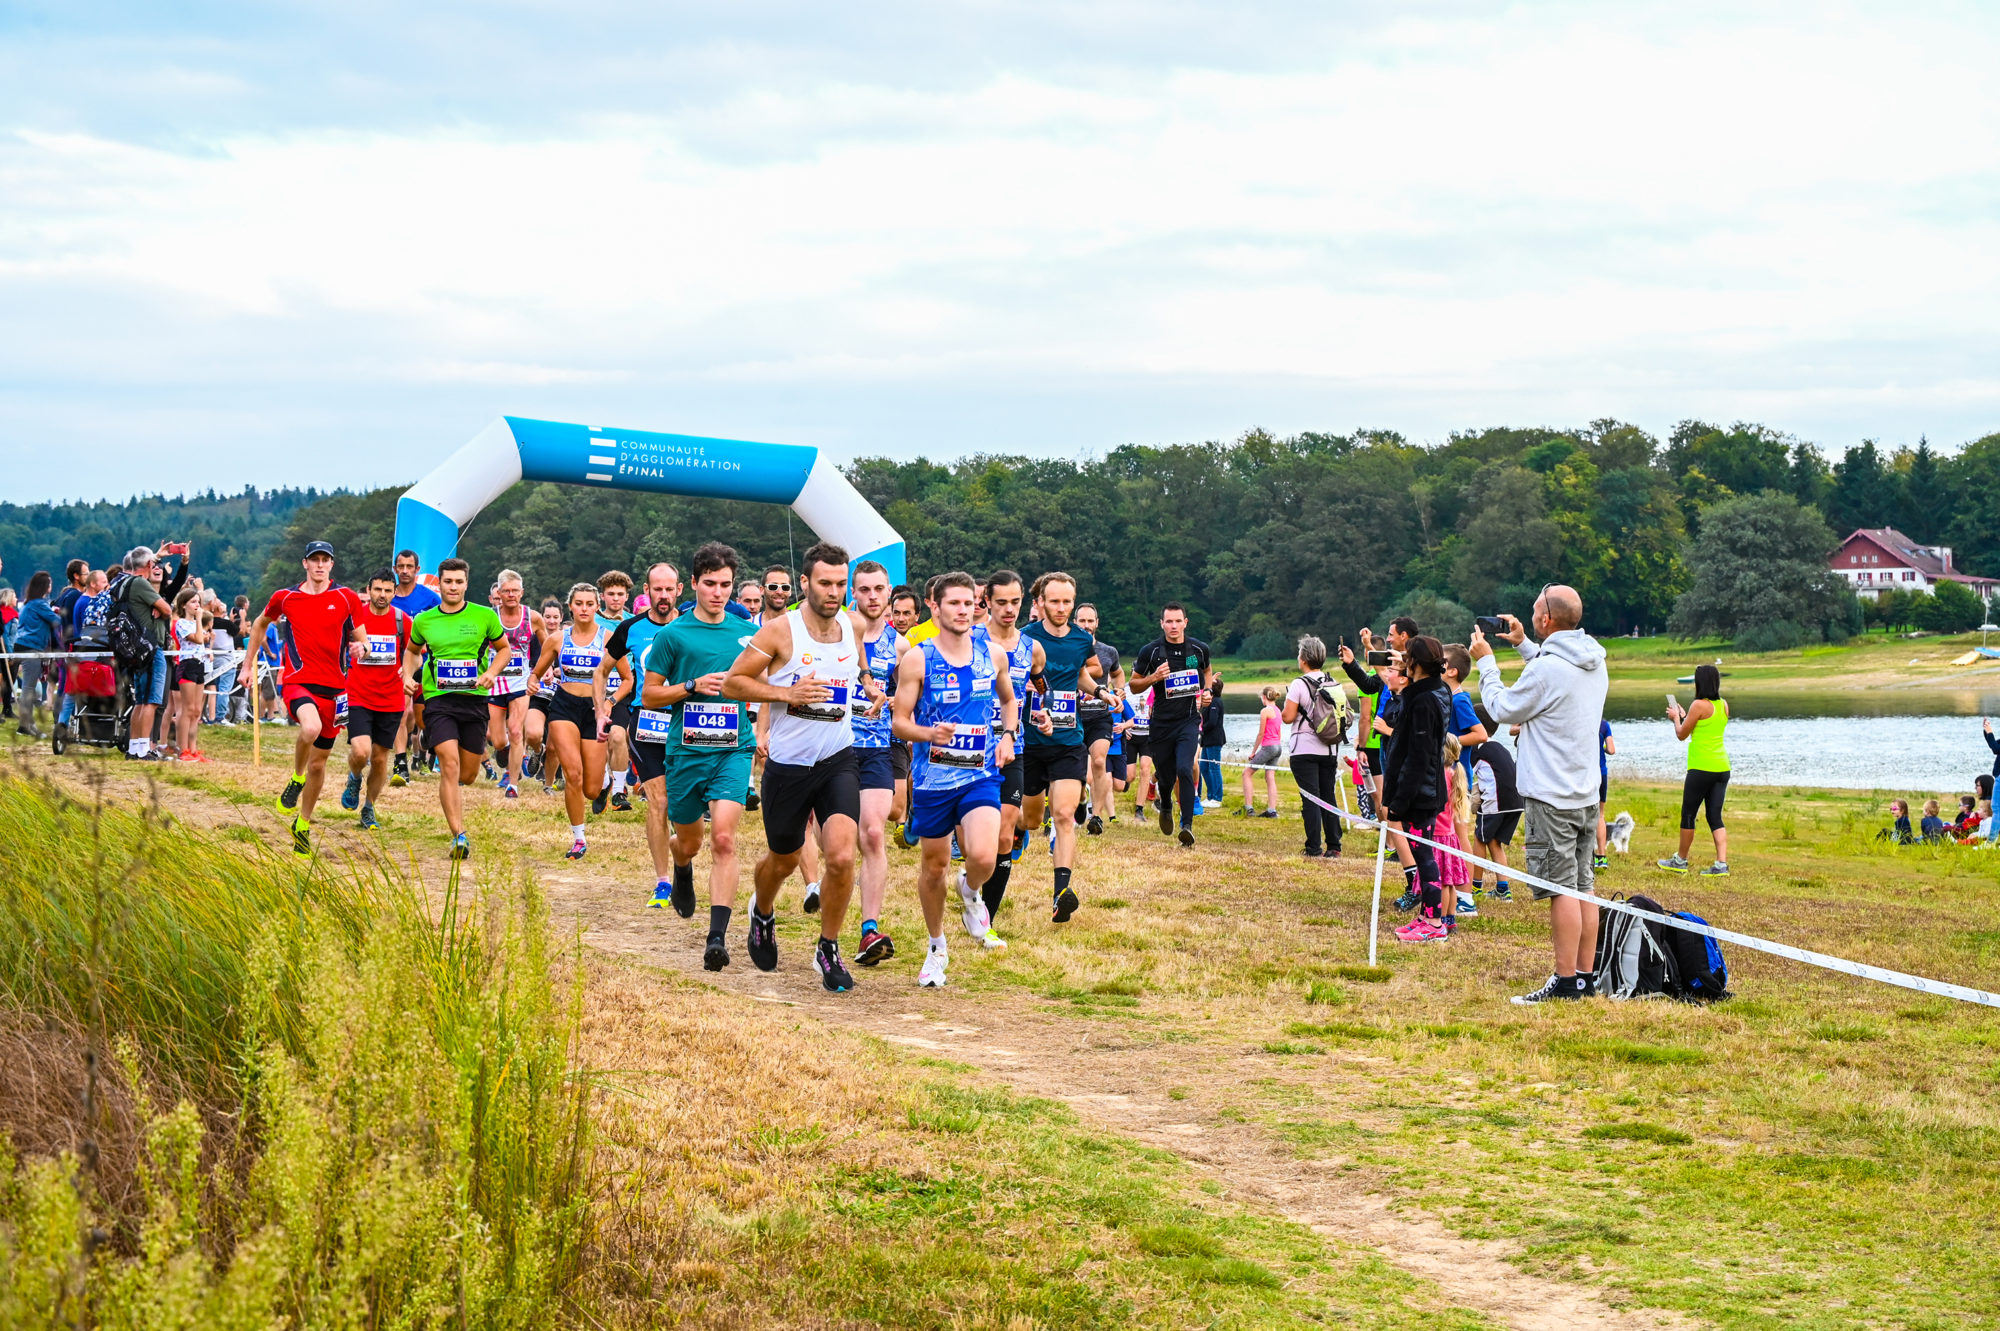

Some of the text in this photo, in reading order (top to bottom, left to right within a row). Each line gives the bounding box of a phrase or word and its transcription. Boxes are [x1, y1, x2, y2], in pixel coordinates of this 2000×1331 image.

[621, 440, 705, 456] COMMUNAUTÉ
[621, 452, 741, 471] D'AGGLOMÉRATION
[619, 463, 665, 478] ÉPINAL
[572, 656, 592, 666] 165
[448, 668, 468, 677] 166
[1174, 677, 1190, 686] 051
[685, 704, 705, 712] AIR
[1052, 701, 1067, 711] 50
[698, 714, 726, 727] 048
[948, 736, 974, 749] 011
